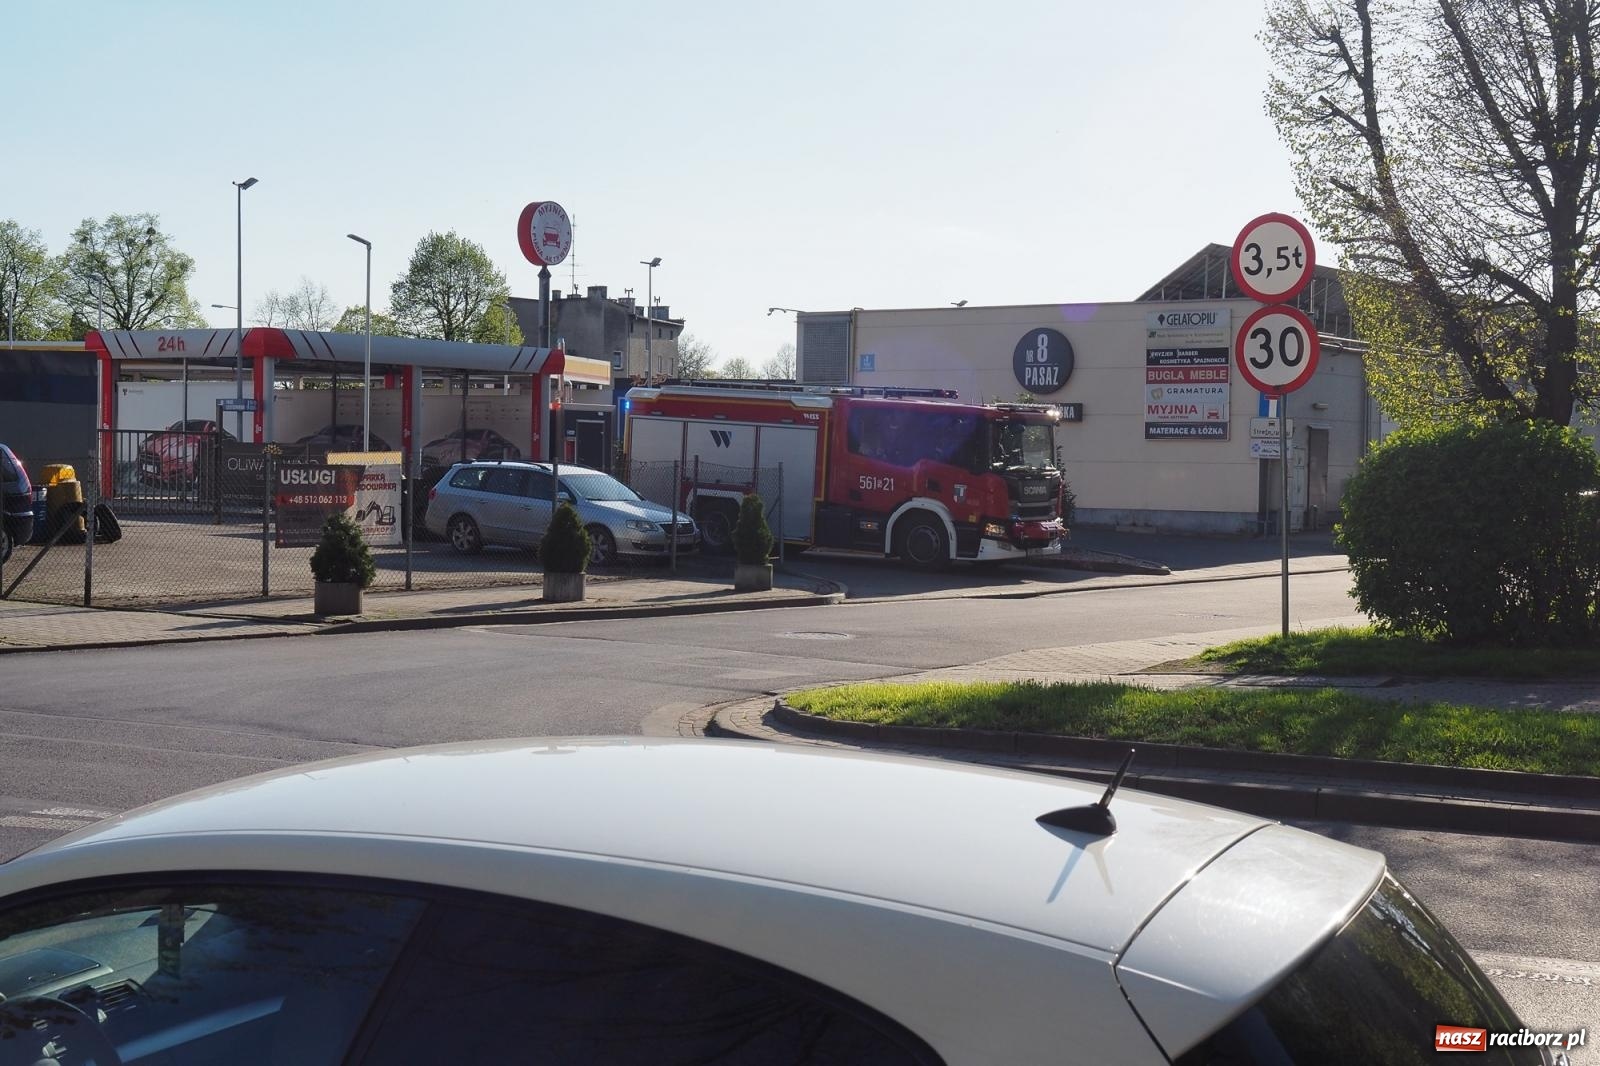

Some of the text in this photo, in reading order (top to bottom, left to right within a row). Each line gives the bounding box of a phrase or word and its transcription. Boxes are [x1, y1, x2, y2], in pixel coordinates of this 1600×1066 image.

[538, 204, 566, 222] MYJNIA
[1244, 242, 1303, 279] 3,5t
[158, 335, 185, 351] 24h
[1026, 333, 1049, 363] NR 8
[1249, 326, 1304, 370] 30
[1148, 369, 1227, 380] BUGLA MEBLE
[1166, 387, 1224, 395] GRAMATURA
[1147, 404, 1198, 415] MYJNIA
[1149, 427, 1188, 435] MATERACE
[281, 469, 335, 485] USŁUGI
[1023, 486, 1048, 496] SCANIA
[289, 495, 347, 504] +48 512 062 113
